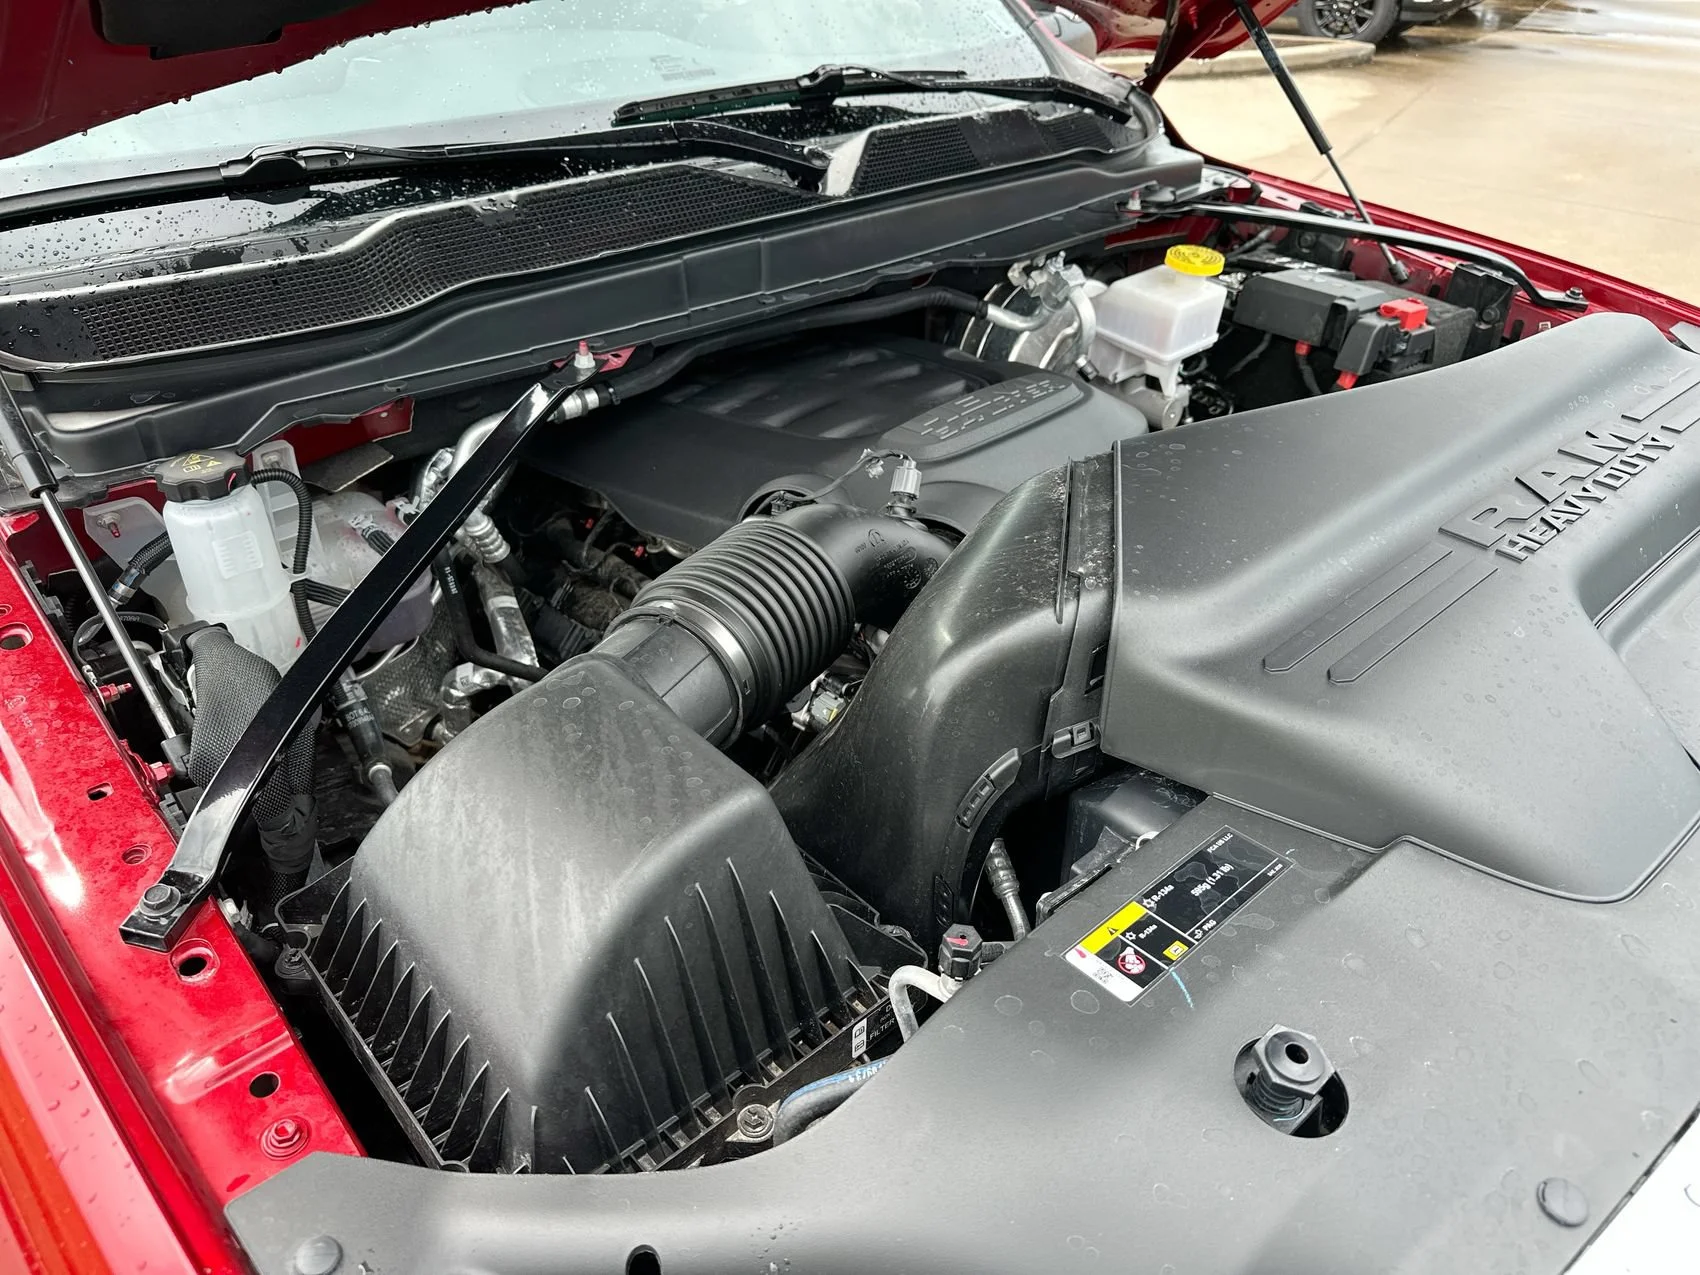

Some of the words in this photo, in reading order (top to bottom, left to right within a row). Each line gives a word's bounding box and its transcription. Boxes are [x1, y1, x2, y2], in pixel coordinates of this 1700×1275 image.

[1438, 420, 1650, 549] RAM
[1494, 482, 1607, 564] HEAVY
[1591, 433, 1675, 491] DUTY
[1222, 832, 1234, 844] LLC
[1151, 884, 1175, 903] R-134a
[1202, 919, 1217, 932] PAG
[869, 1018, 895, 1041] FILTER
